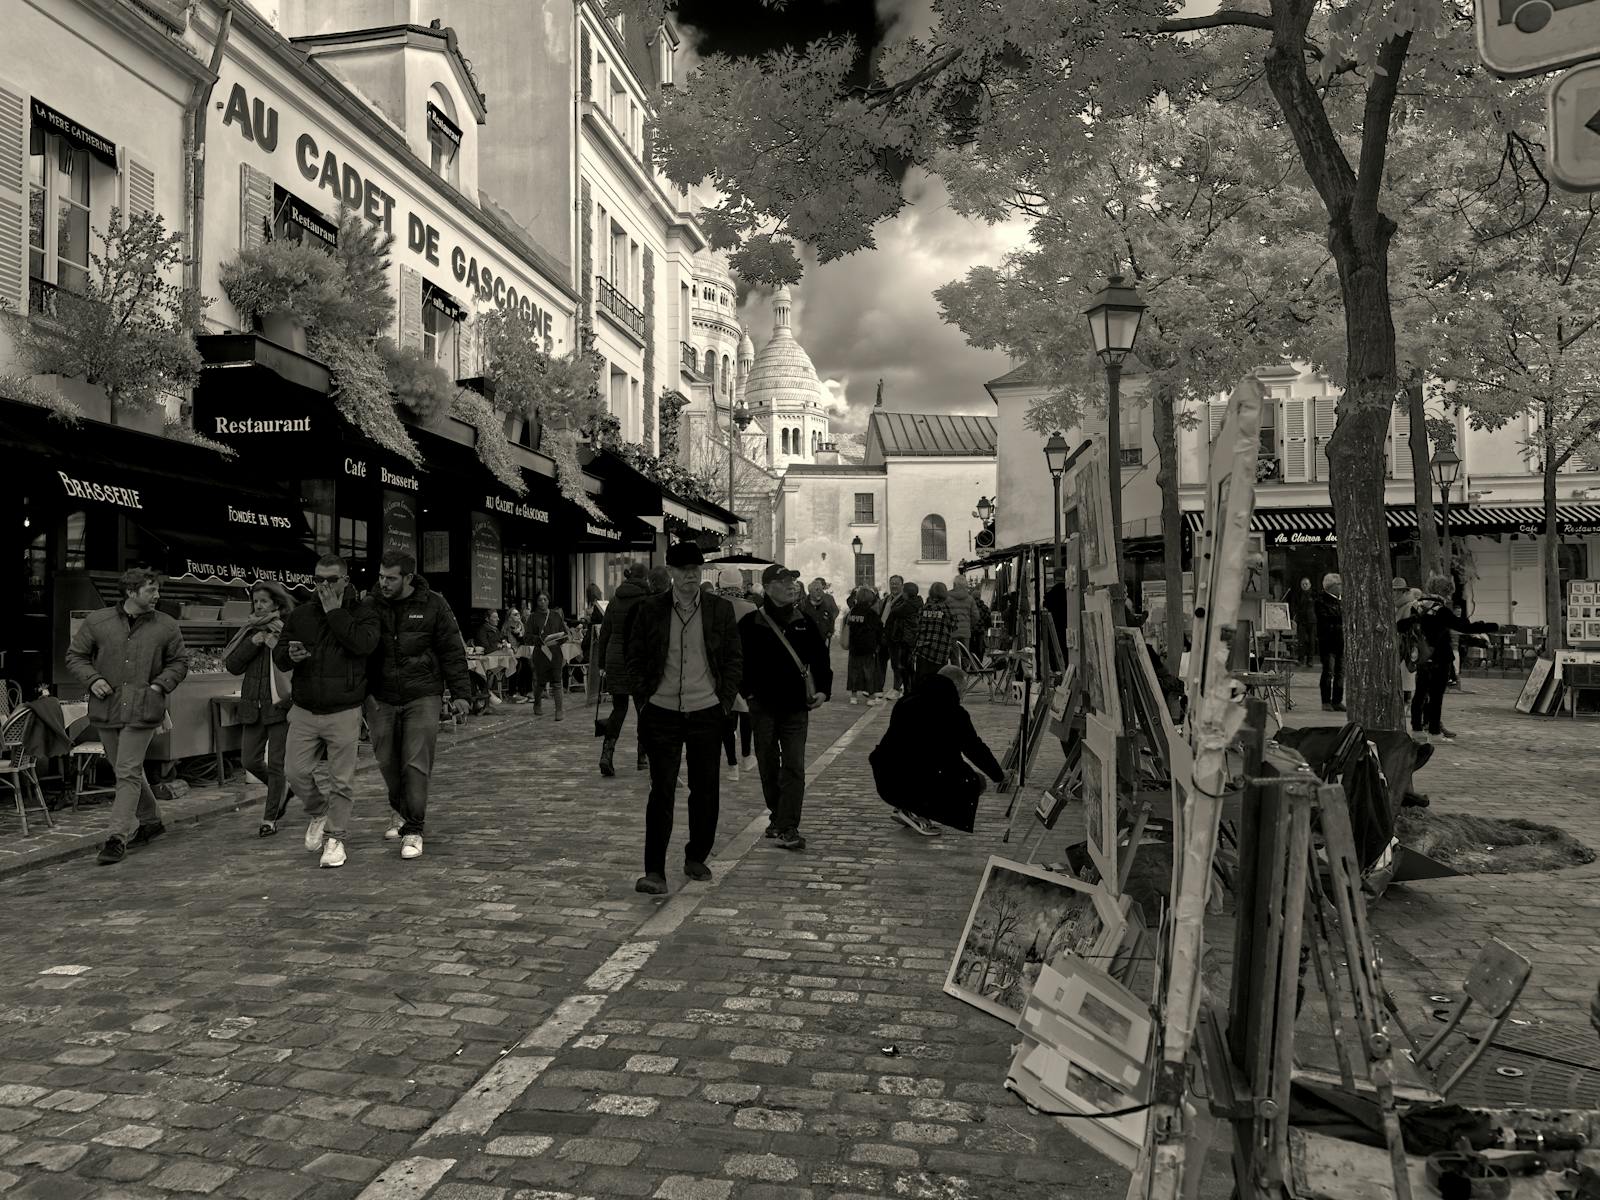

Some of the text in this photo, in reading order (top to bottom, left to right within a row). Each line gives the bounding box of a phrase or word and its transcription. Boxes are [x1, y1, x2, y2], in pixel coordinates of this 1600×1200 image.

[34, 104, 47, 119] LA
[71, 126, 114, 156] CATHERINE
[223, 83, 553, 341] AU CADET DE GASCOGNE
[292, 206, 336, 245] Restaurant
[214, 416, 311, 433] Restaurant
[56, 470, 143, 509] BRASSERIE
[345, 458, 419, 490] Café Brasserie
[258, 514, 269, 526] EN
[270, 516, 291, 528] 1793
[1275, 533, 1288, 543] Au
[186, 559, 215, 574] FRUITS
[217, 565, 228, 576] DE
[230, 564, 246, 577] MER
[252, 566, 278, 580] VENTE
